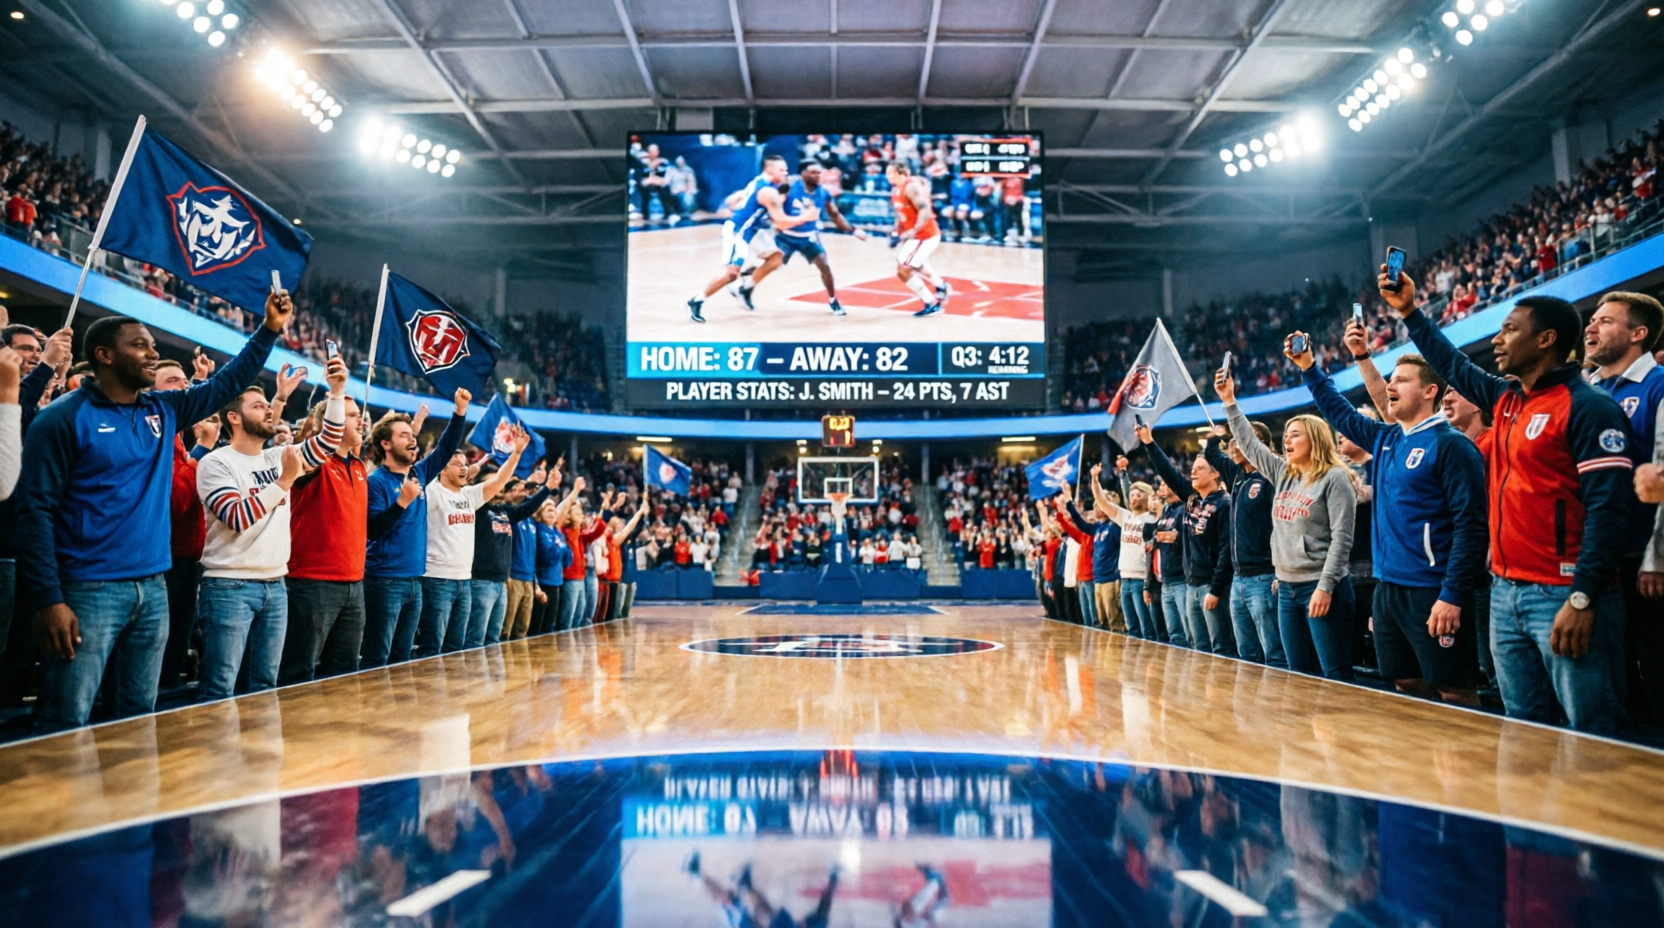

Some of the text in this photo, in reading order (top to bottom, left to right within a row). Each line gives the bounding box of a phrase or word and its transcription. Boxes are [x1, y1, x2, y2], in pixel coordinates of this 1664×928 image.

[641, 346, 720, 371] HOME:
[727, 346, 759, 371] 87
[789, 346, 869, 371] AWAY:
[875, 346, 908, 371] 82
[951, 345, 1030, 368] Q3: 4:12
[666, 382, 732, 400] PLAYER
[736, 382, 795, 400] STATS:
[798, 382, 815, 400] J.
[818, 382, 874, 400] SMITH
[893, 382, 915, 400] 24
[919, 382, 957, 404] PTS,
[960, 382, 973, 400] 7
[975, 382, 1010, 400] AST
